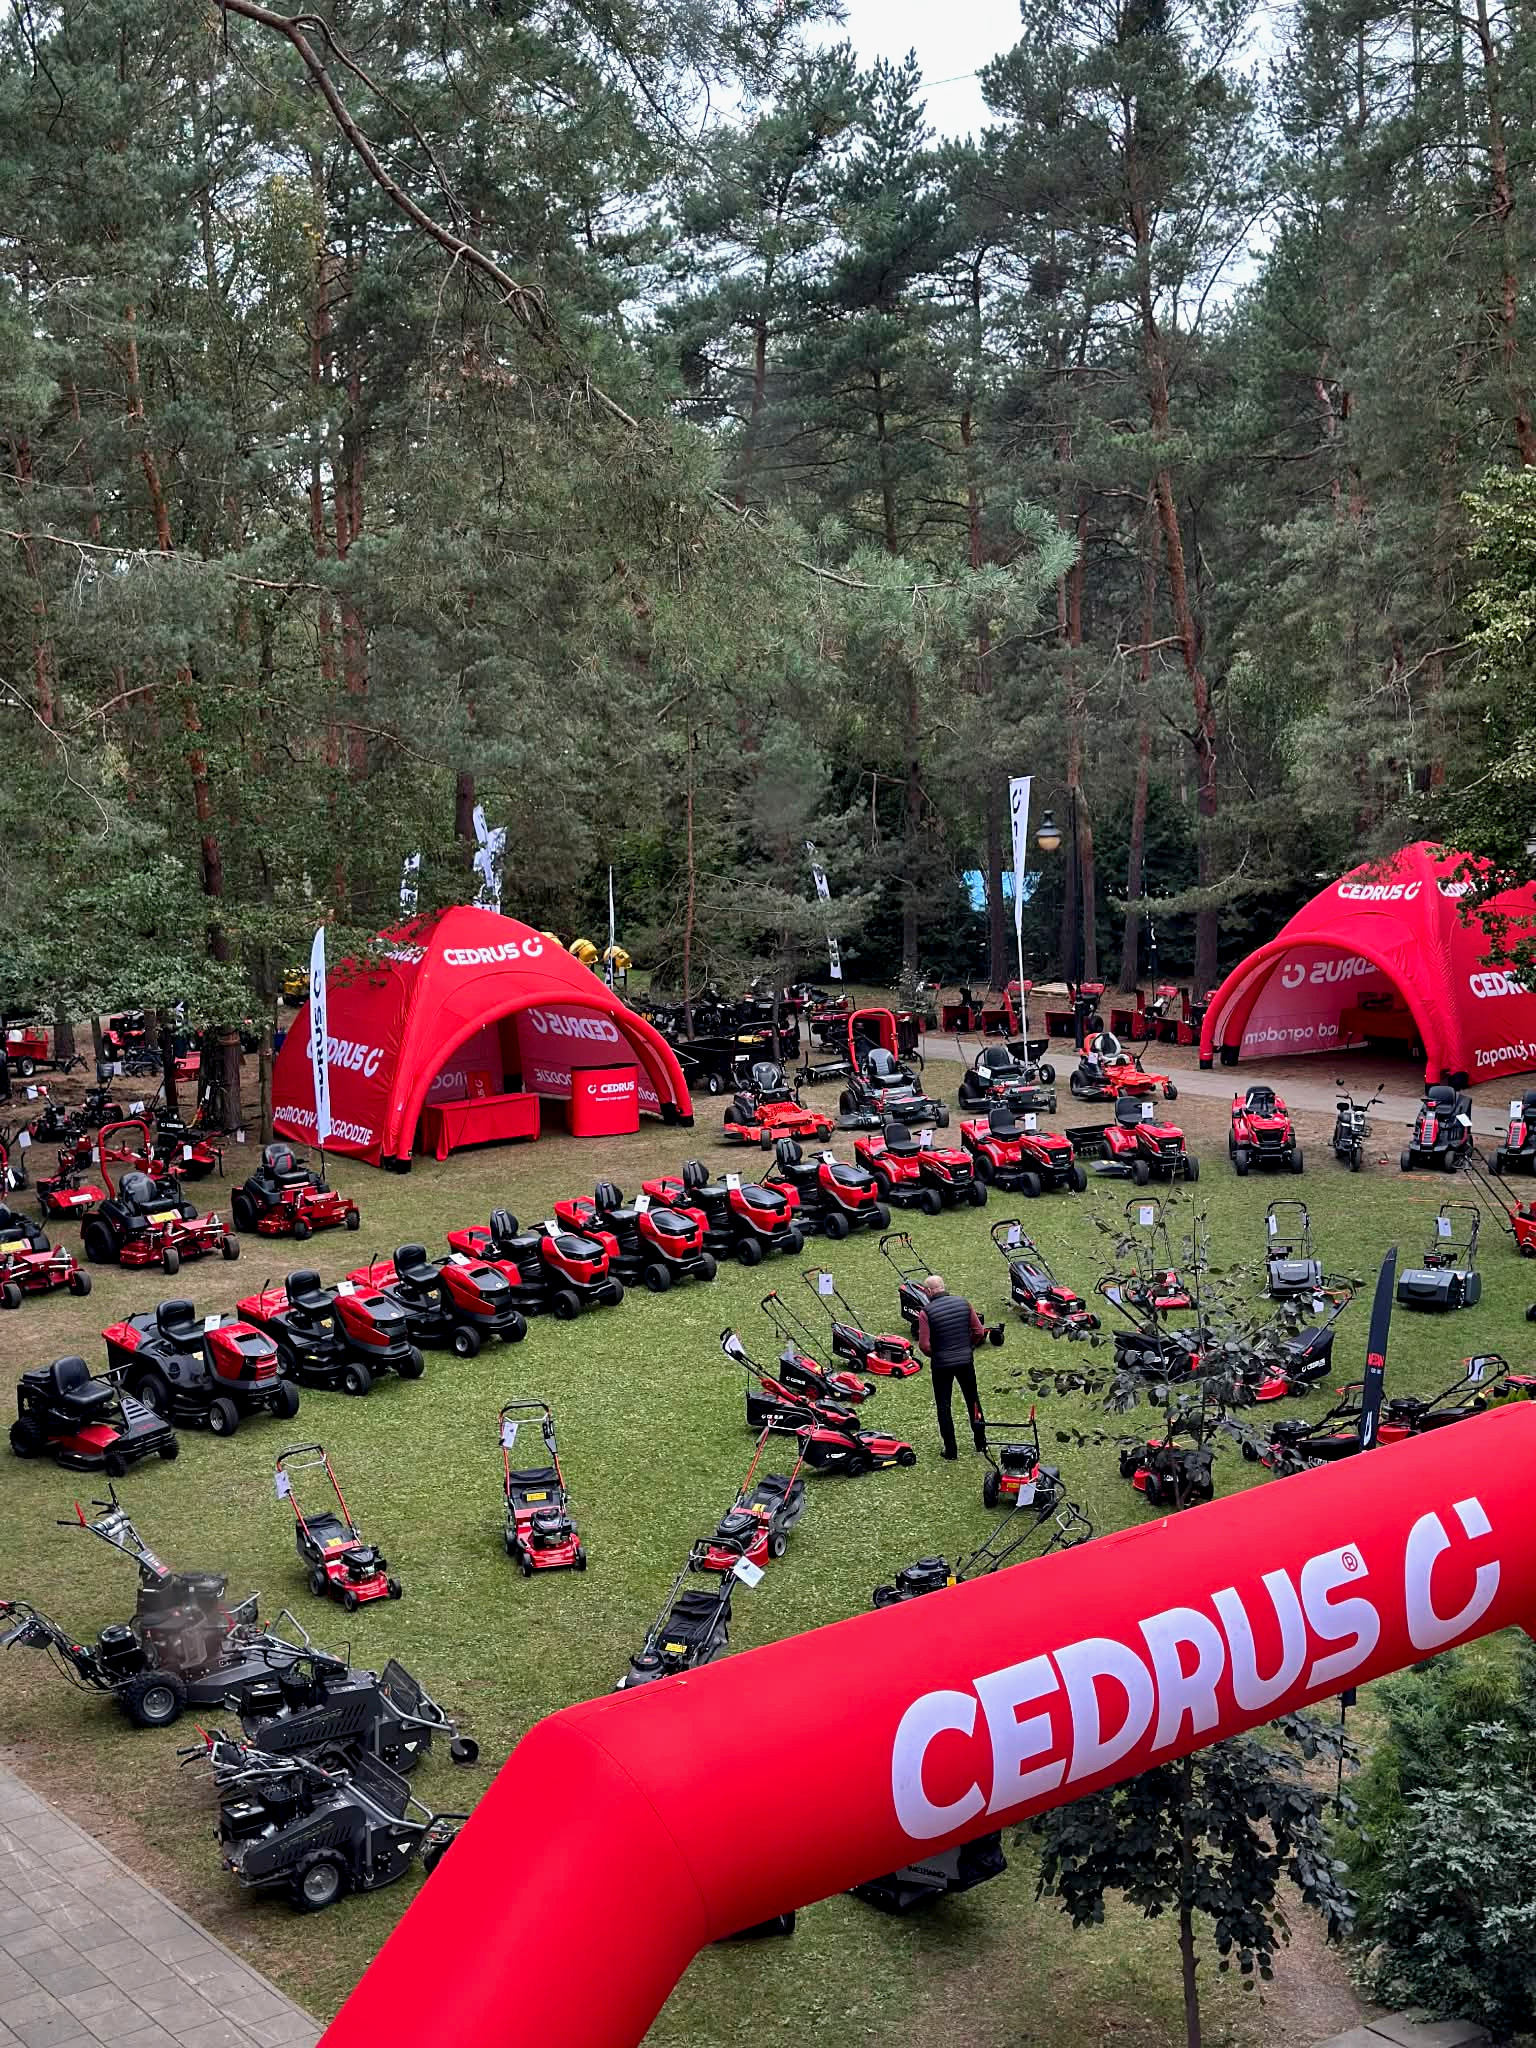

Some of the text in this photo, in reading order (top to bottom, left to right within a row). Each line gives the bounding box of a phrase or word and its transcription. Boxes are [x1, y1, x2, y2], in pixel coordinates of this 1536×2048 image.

[1337, 883, 1406, 900] CEDRUS
[443, 942, 520, 966] CEDRUS
[1475, 1040, 1528, 1068] Zapanuj
[601, 1081, 635, 1094] CEDRUS
